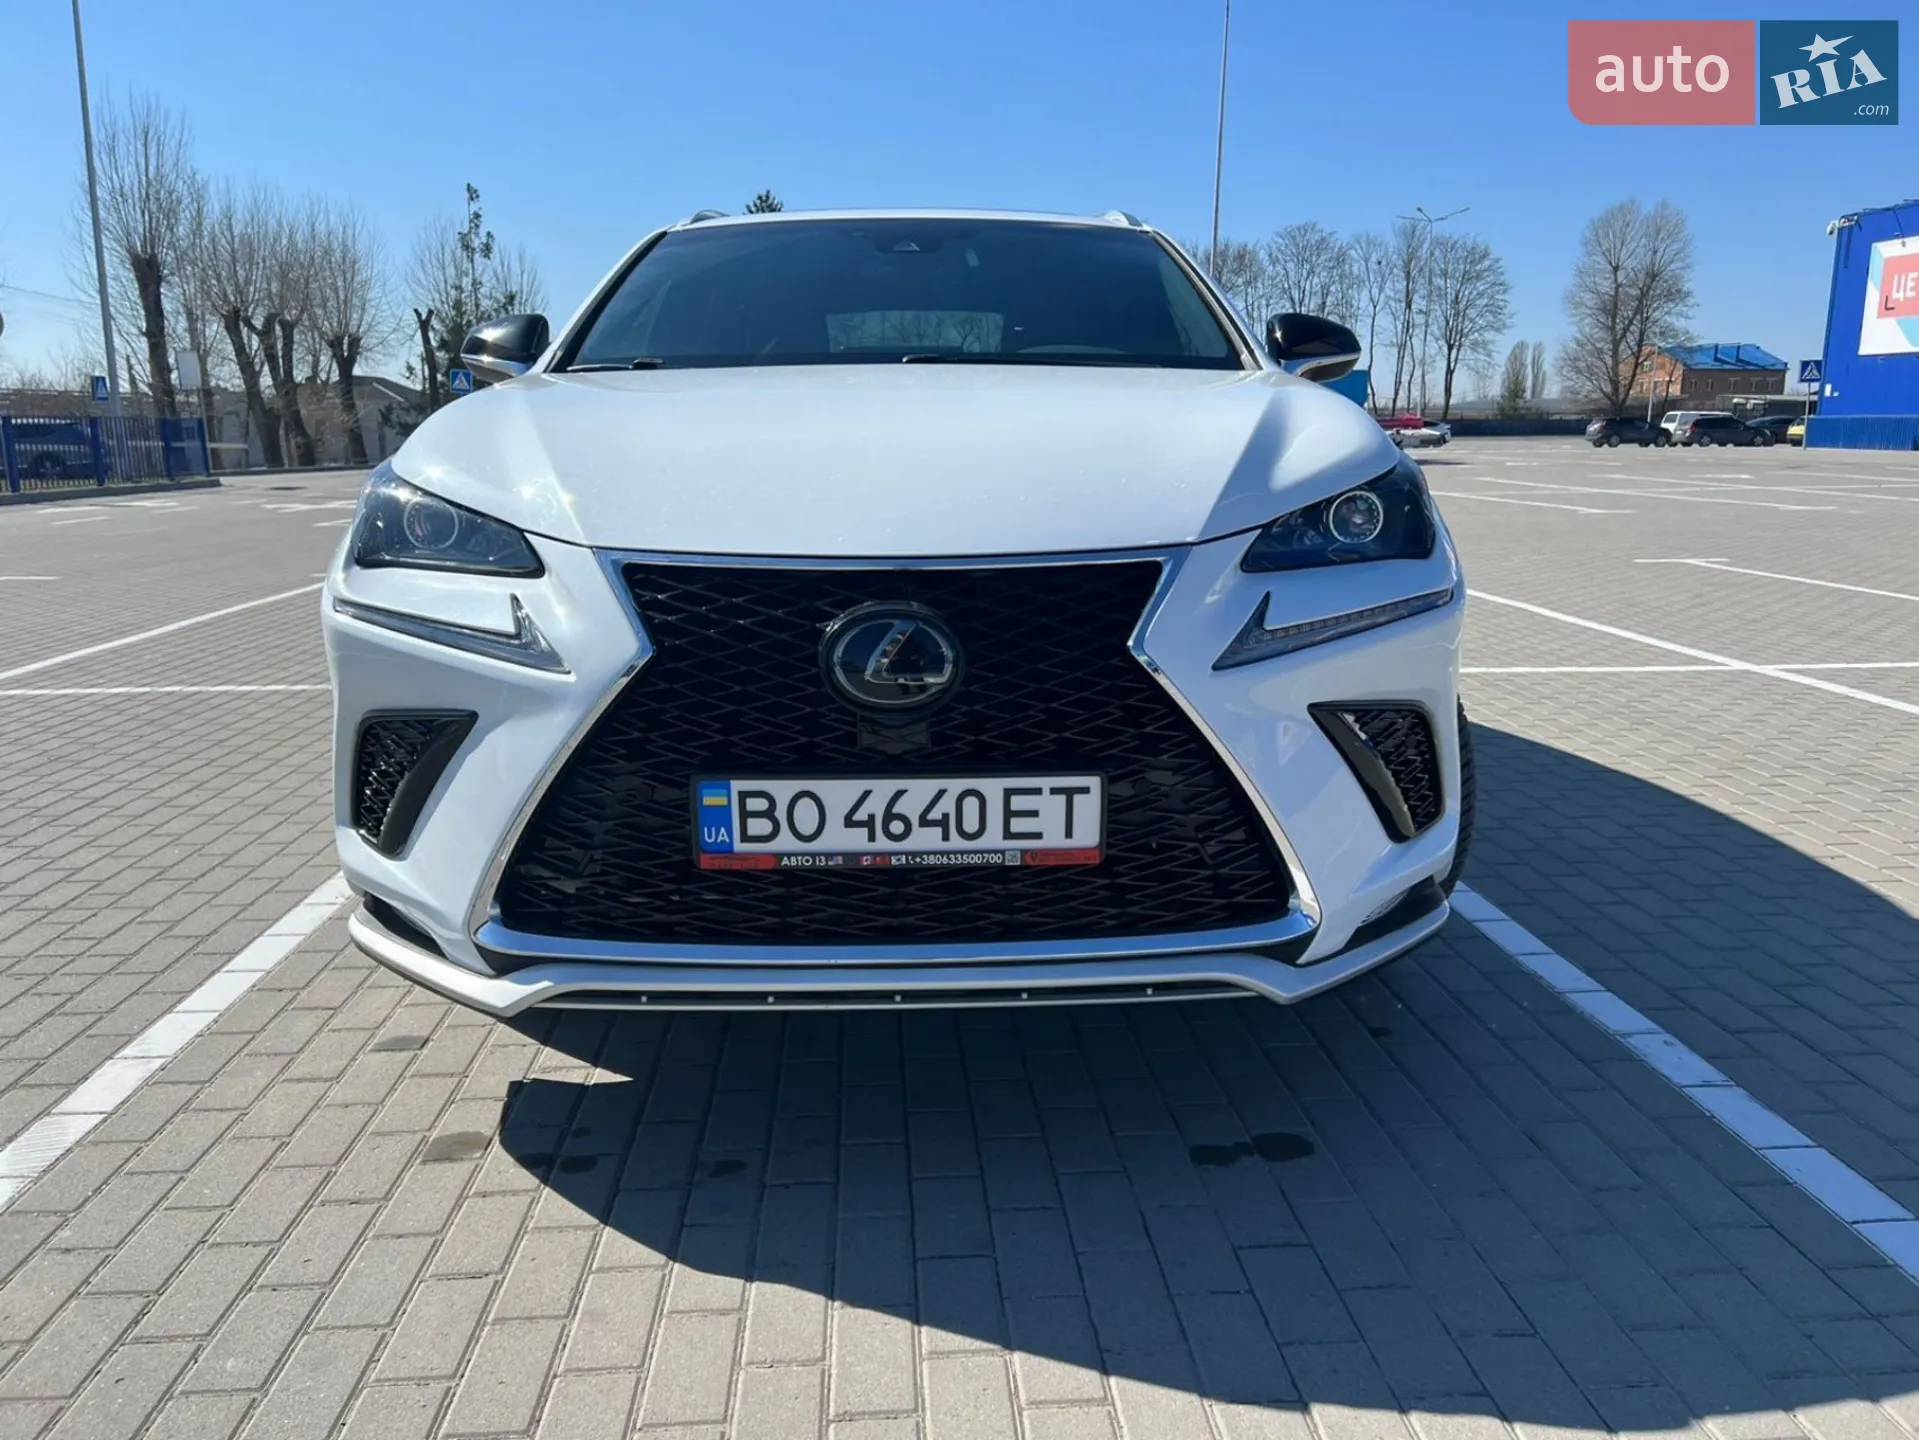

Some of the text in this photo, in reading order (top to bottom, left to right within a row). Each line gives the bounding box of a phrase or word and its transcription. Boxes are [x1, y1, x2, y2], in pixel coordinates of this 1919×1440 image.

[737, 786, 1091, 844] BO 4640 ET
[703, 827, 730, 843] UA
[915, 853, 1003, 865] +380633500700
